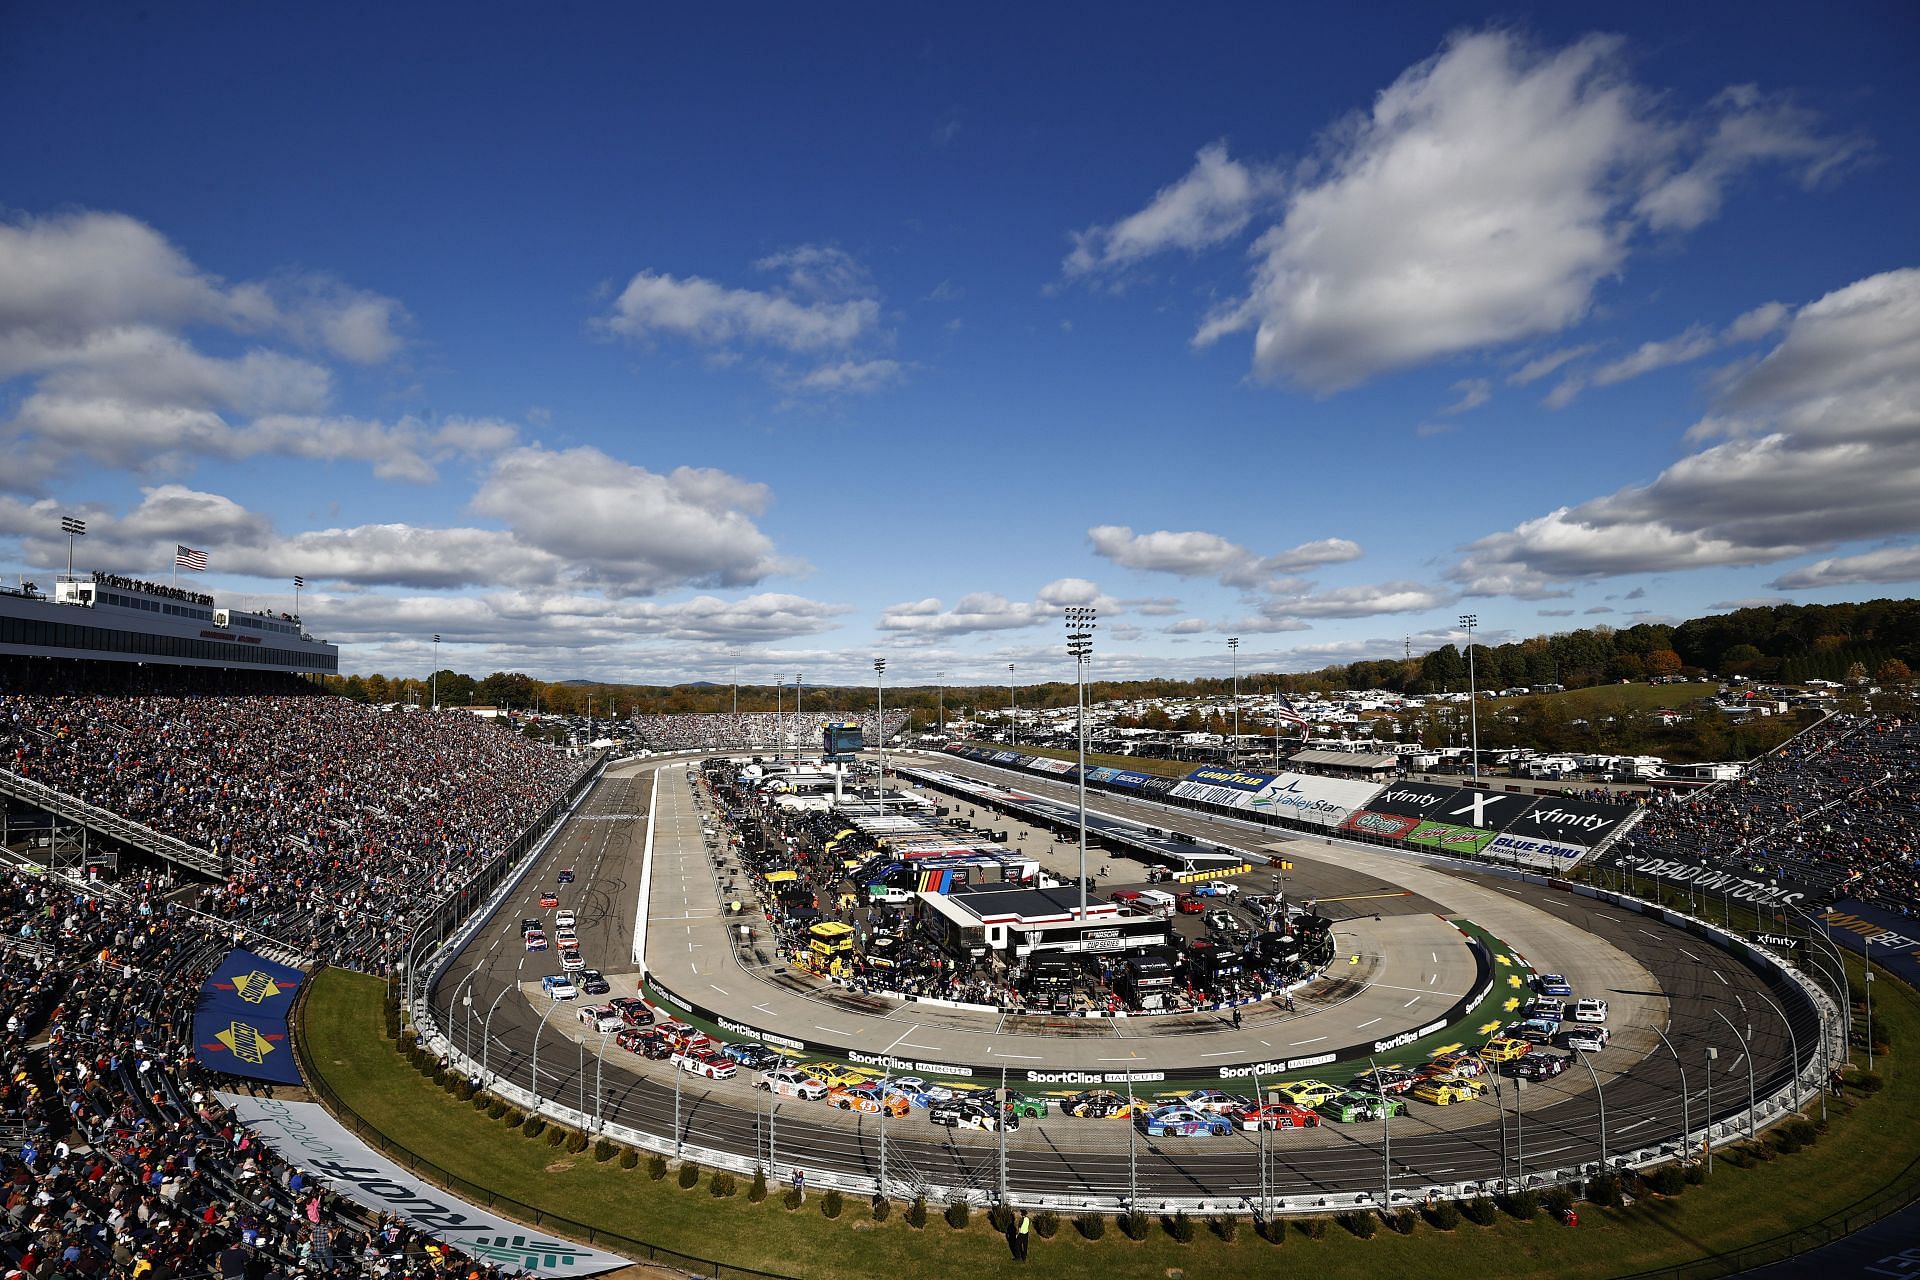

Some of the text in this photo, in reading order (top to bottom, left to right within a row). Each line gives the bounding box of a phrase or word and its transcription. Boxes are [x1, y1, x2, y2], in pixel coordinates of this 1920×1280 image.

[1201, 787, 1243, 805] VODKA
[1380, 789, 1443, 807] xfinity
[1526, 808, 1615, 832] xfinity
[1186, 859, 1196, 871] X
[1636, 858, 1700, 881] DEAD
[1692, 870, 1732, 890] ON
[1087, 940, 1120, 949] CUP SERIES
[1756, 933, 1798, 949] xfinity
[241, 972, 272, 1003] SUNOCO
[718, 1017, 760, 1040] SportClips
[233, 1023, 261, 1062] SUNOCO
[1374, 1031, 1418, 1053] SportClips
[691, 1061, 700, 1071] 21
[848, 1051, 971, 1076] SportClips HAIRCUTS
[1220, 1054, 1335, 1079] SportClips HAIRCUTS
[1027, 1071, 1163, 1084] SportClips HAIRCUTS
[1462, 1087, 1472, 1098] 20
[860, 1101, 873, 1111] 43
[1105, 1105, 1118, 1115] 14
[971, 1115, 981, 1126] 8
[1183, 1123, 1199, 1134] 17
[1281, 1117, 1294, 1127] 23
[307, 1158, 495, 1231] ruoff
